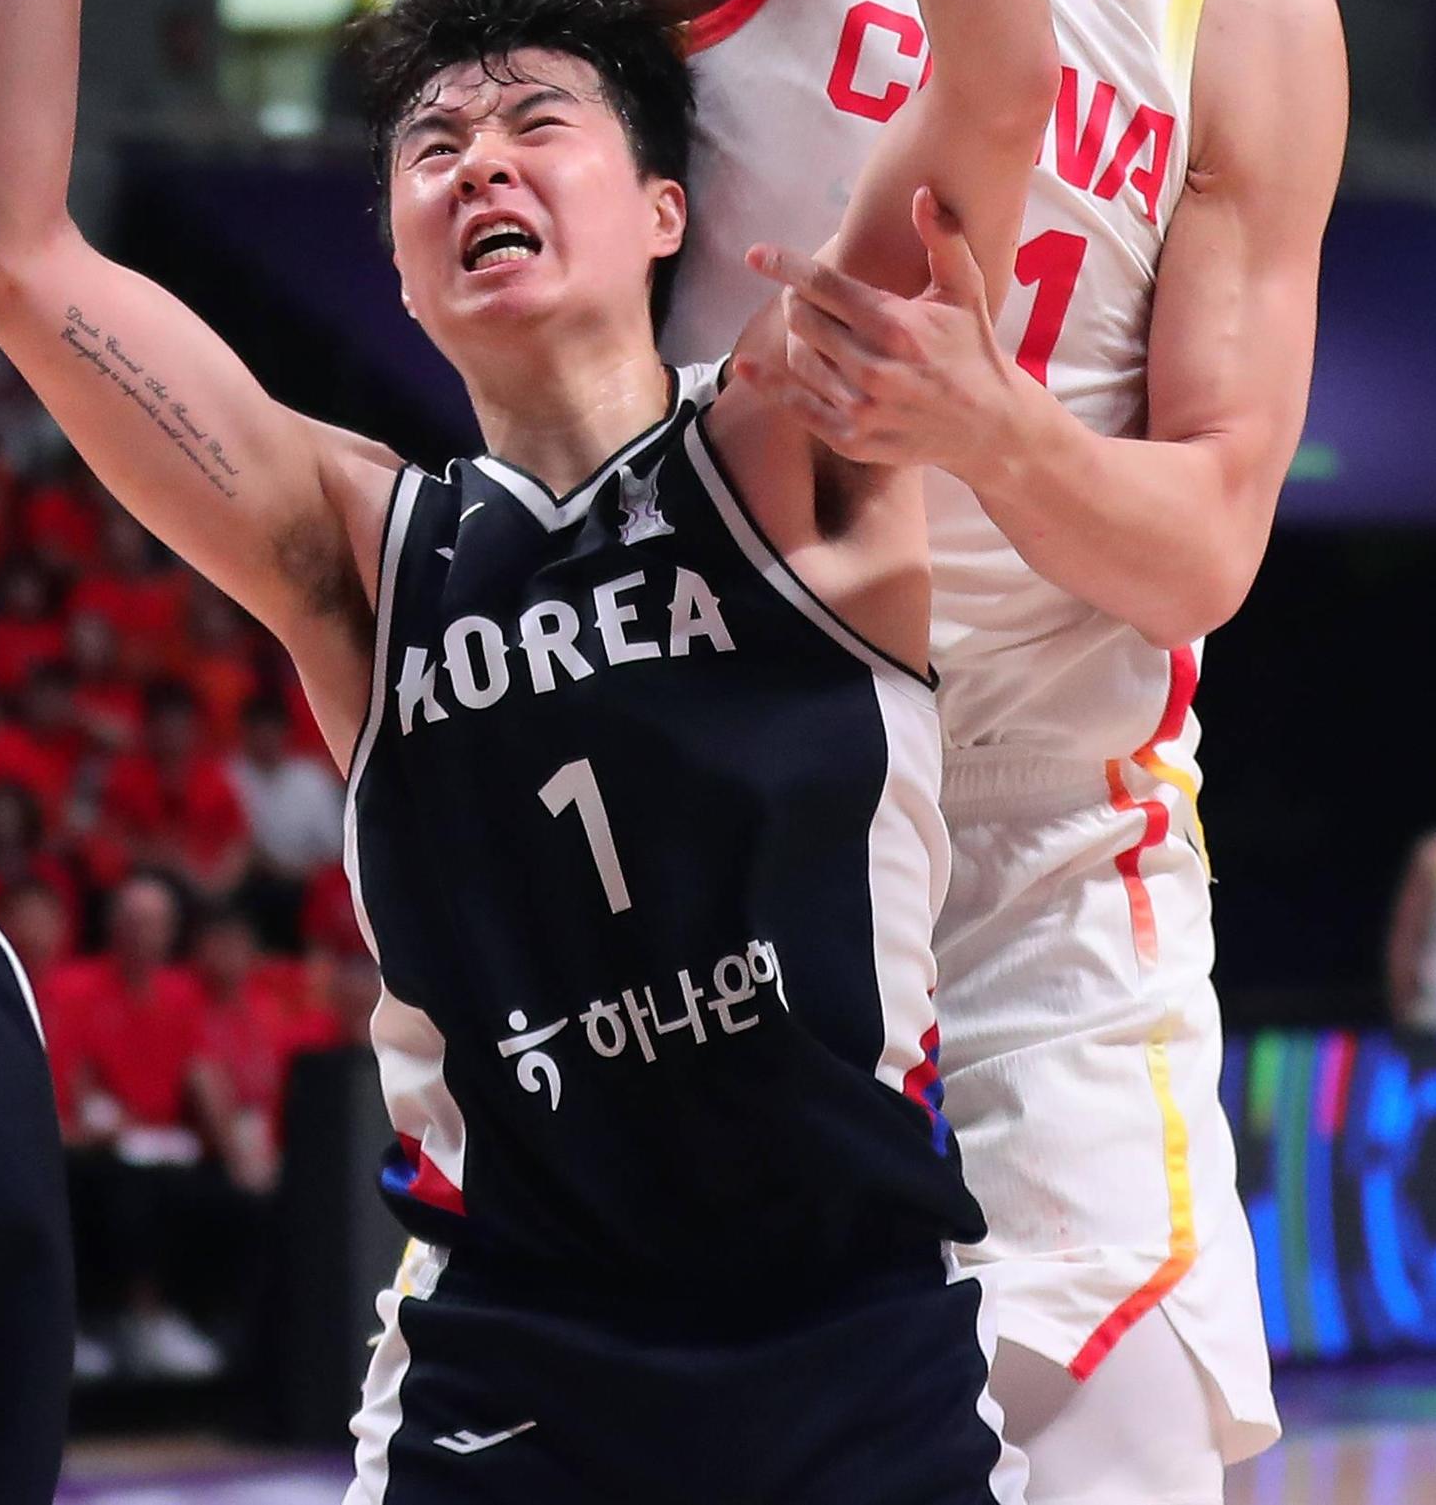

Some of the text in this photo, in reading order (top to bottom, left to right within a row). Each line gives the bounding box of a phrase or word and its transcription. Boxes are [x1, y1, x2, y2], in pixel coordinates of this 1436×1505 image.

[827, 0, 1174, 226] CNA
[395, 565, 737, 737] KOREA
[537, 758, 632, 914] 1
